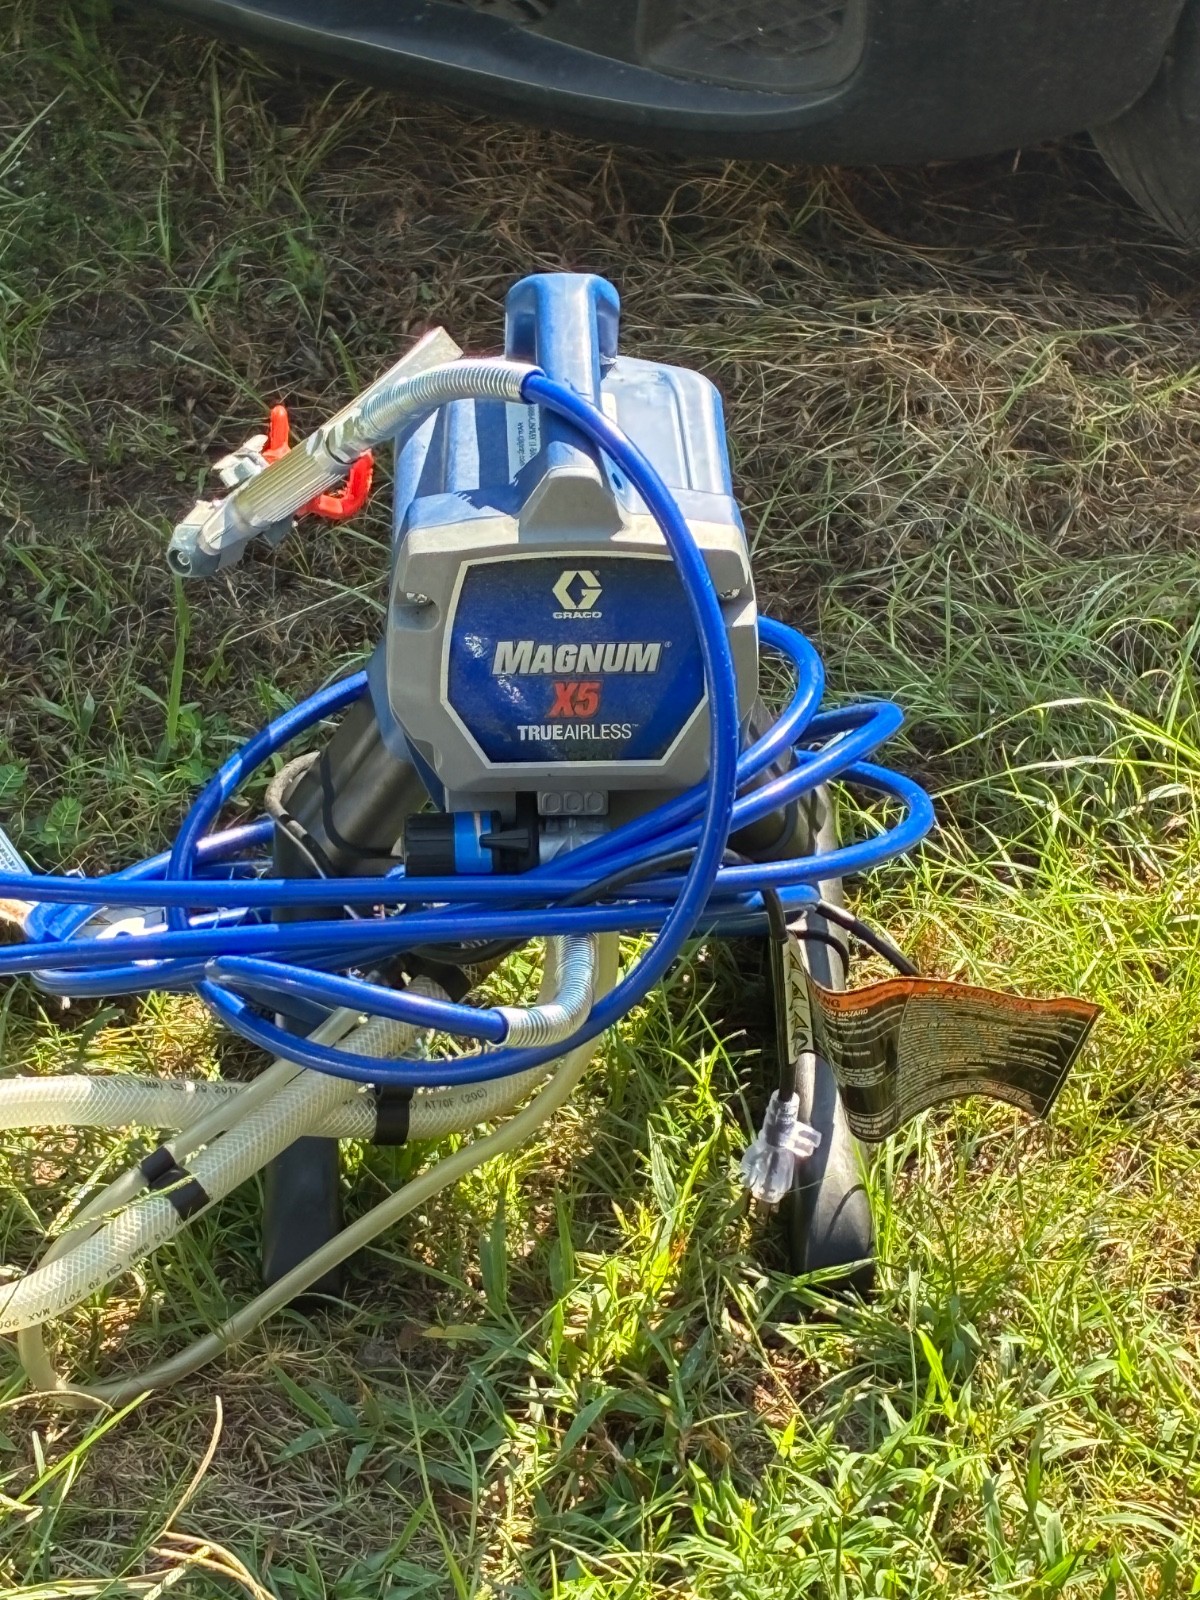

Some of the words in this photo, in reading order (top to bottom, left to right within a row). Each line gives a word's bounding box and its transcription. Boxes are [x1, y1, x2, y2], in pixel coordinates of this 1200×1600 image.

[552, 611, 603, 620] GRACO
[492, 640, 662, 676] MAGNUM
[547, 681, 602, 719] X5
[517, 723, 633, 741] TRUEAIRLESS
